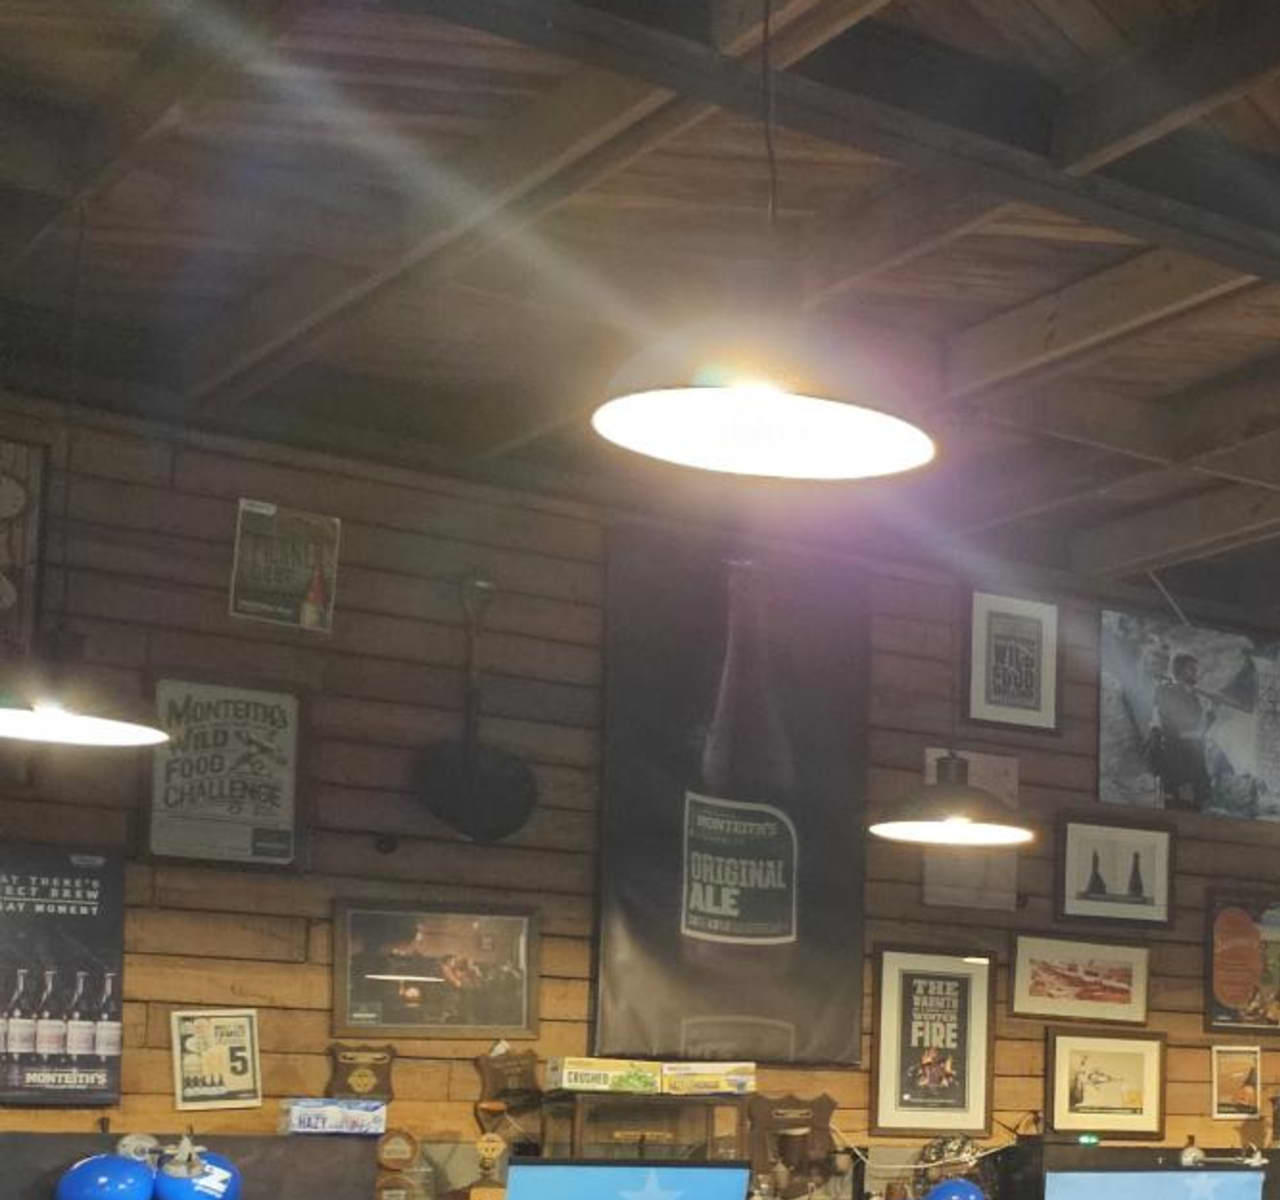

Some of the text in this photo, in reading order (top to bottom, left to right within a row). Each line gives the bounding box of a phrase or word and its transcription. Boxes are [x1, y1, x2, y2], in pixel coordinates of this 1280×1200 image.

[691, 851, 787, 889] ORIGINAL
[688, 881, 741, 918] ALE
[912, 978, 960, 996] THE
[910, 1020, 959, 1049] FIRE
[228, 1046, 249, 1076] 5
